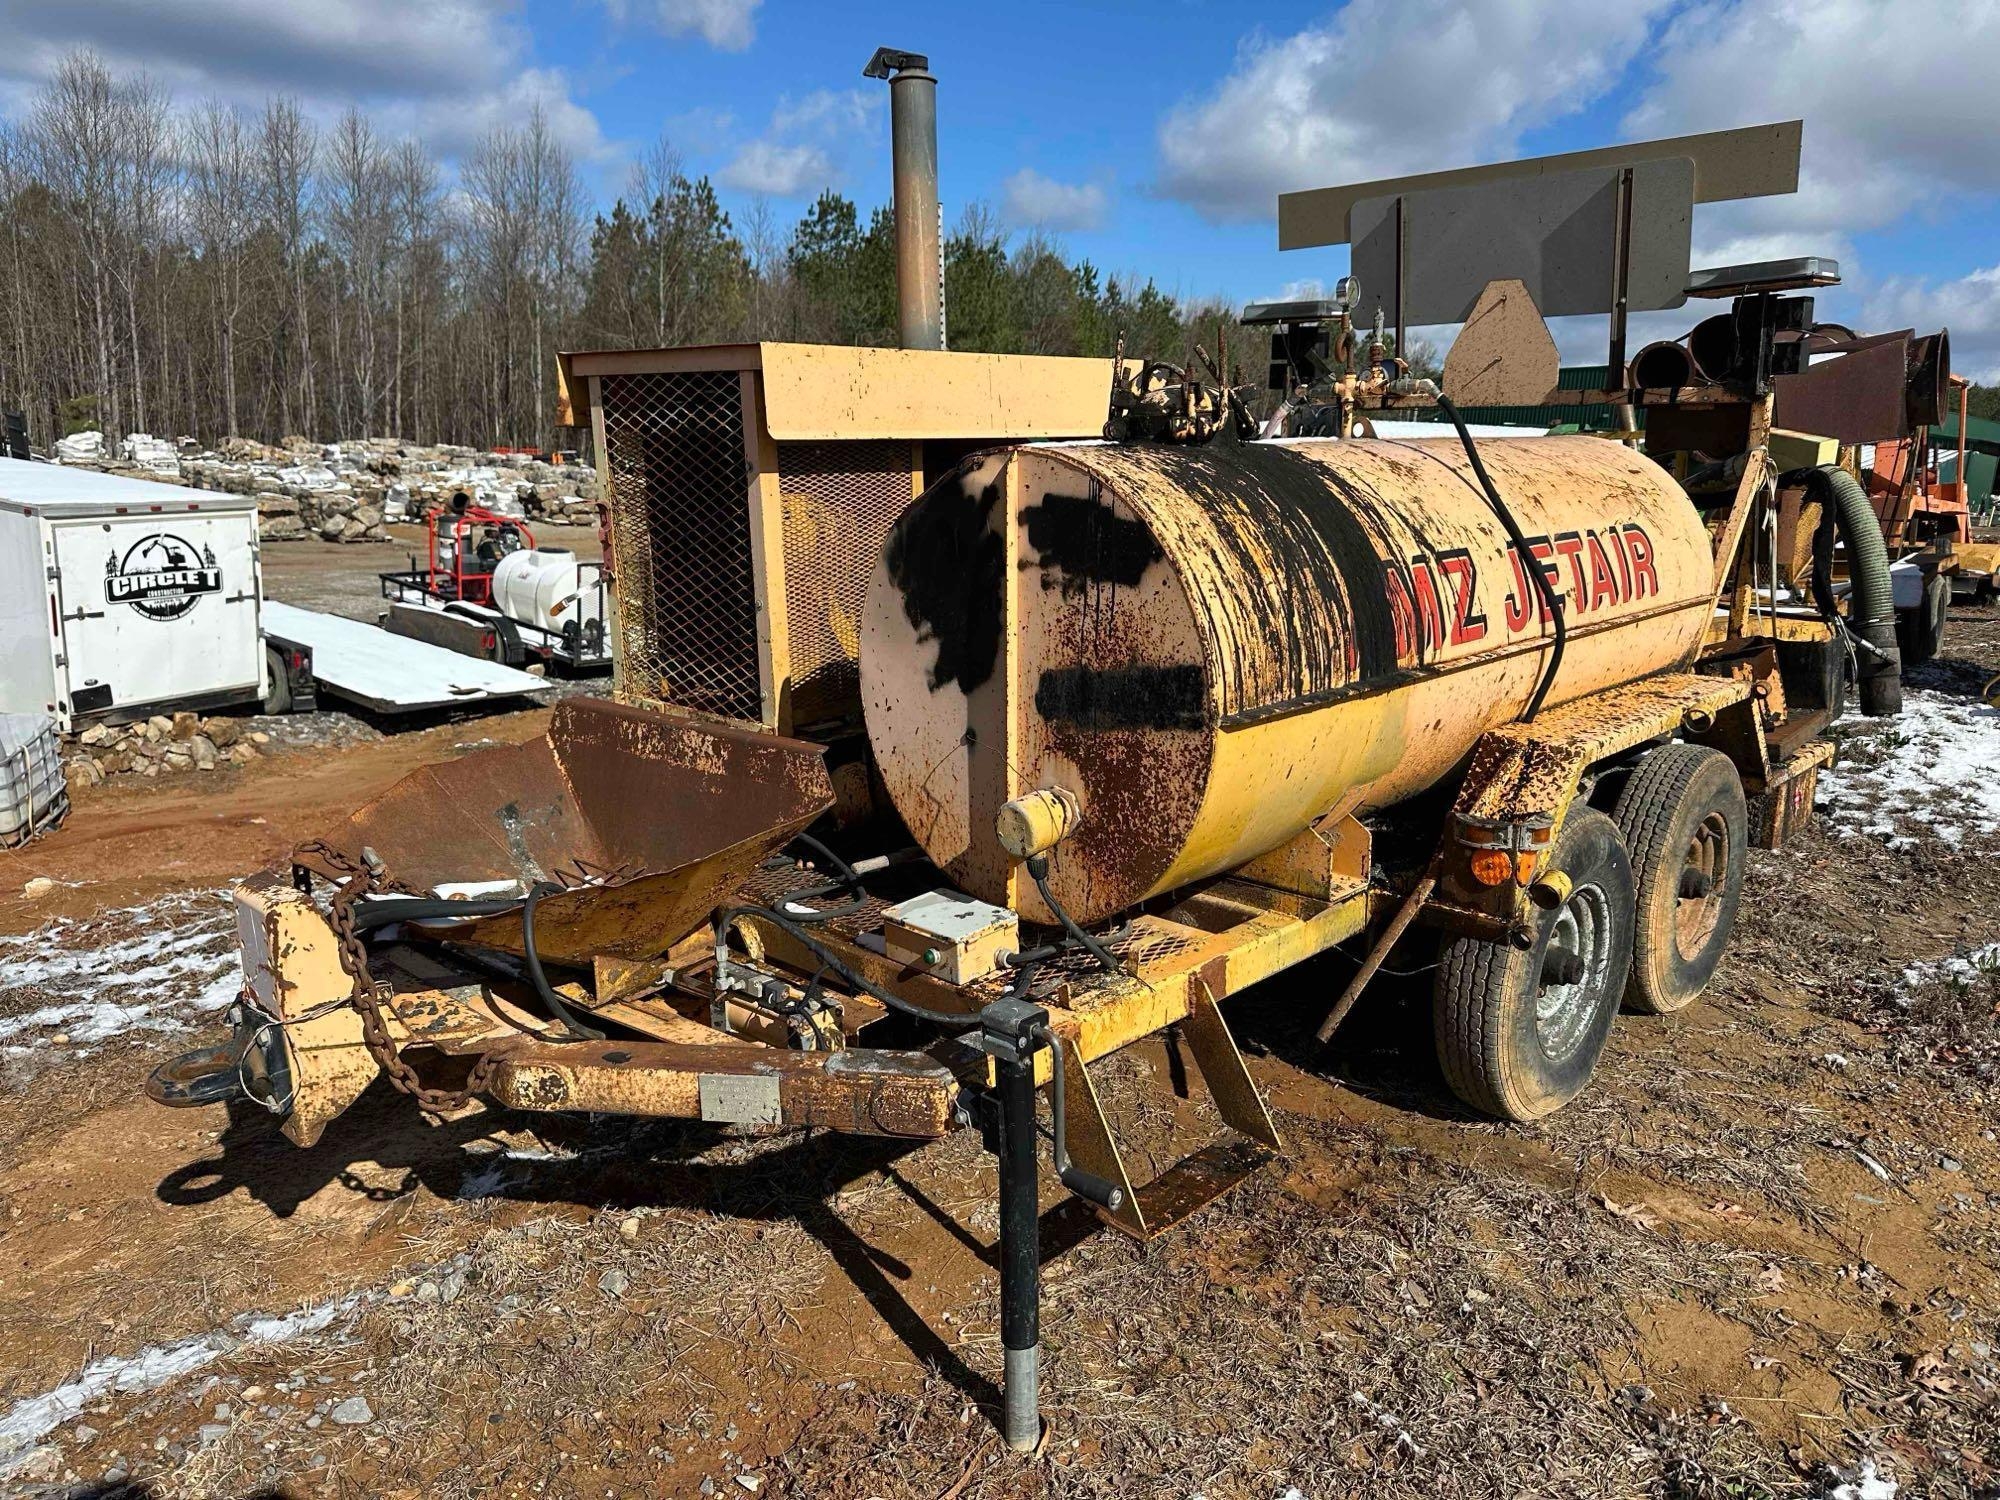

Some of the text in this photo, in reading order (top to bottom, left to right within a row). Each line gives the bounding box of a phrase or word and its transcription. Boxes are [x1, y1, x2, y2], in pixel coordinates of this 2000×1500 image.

[112, 570, 218, 596] CIRCLE T
[1348, 523, 1659, 672] MZ JETAIR
